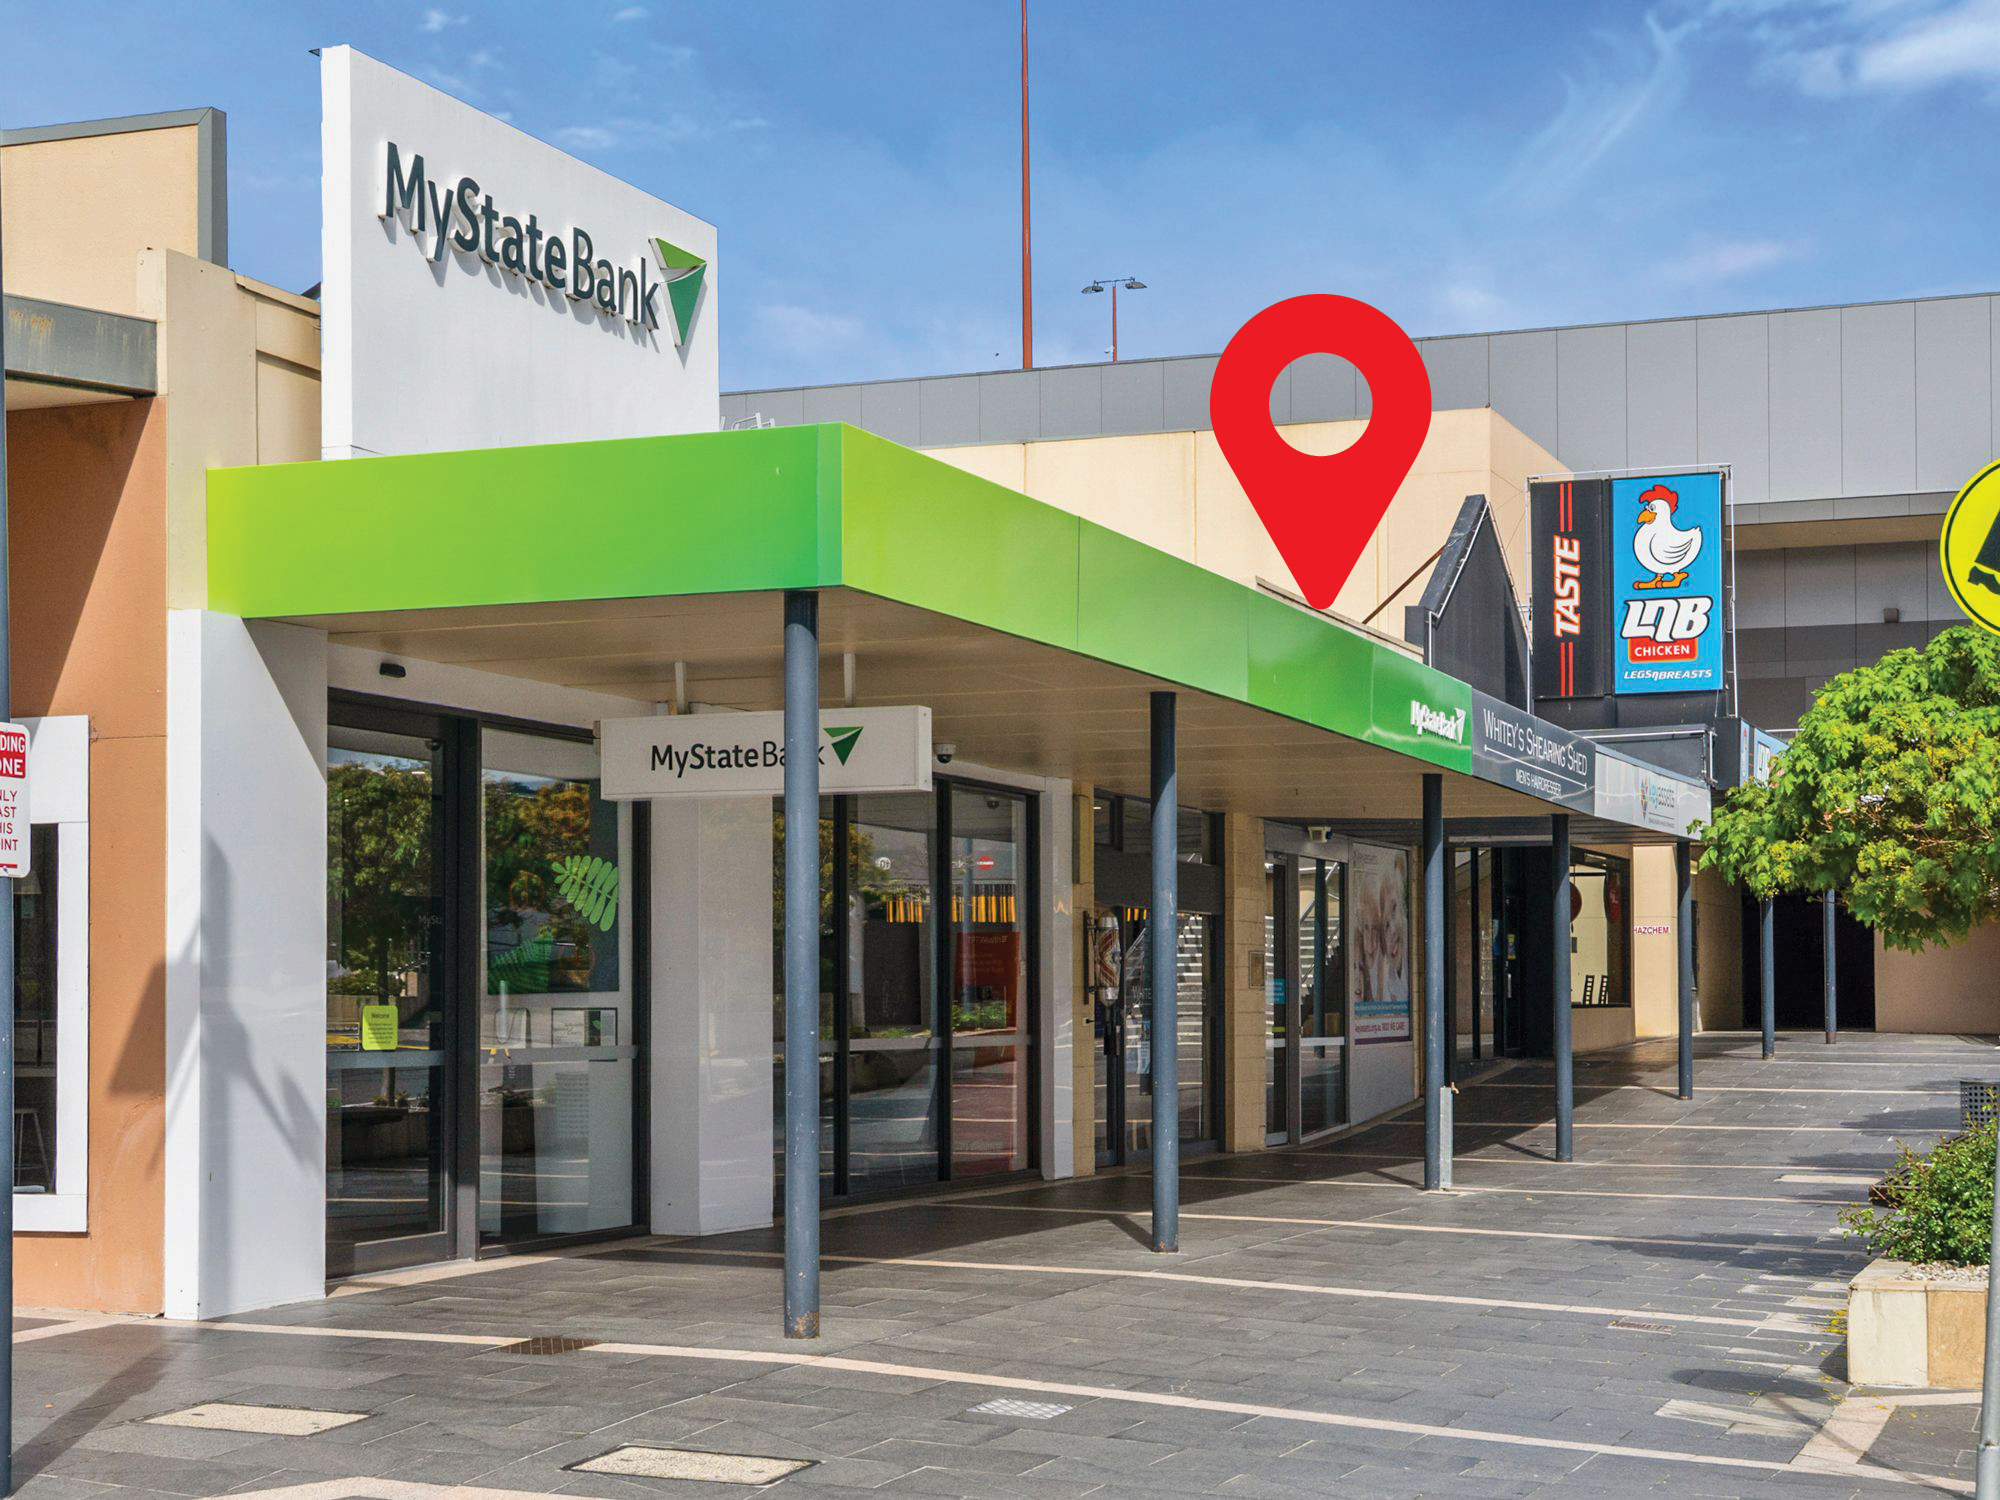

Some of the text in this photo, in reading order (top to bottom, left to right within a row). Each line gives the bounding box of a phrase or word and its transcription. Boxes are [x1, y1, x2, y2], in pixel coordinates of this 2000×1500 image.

[386, 141, 659, 331] MyStateBank
[1553, 534, 1581, 638] TASTE
[1634, 644, 1690, 657] CHICKEN
[651, 741, 825, 778] MyStateB
[1483, 708, 1588, 776] WHITEY'S SHEARING SHED
[0, 758, 24, 776] NE
[1632, 927, 1669, 935] HAZCHEM
